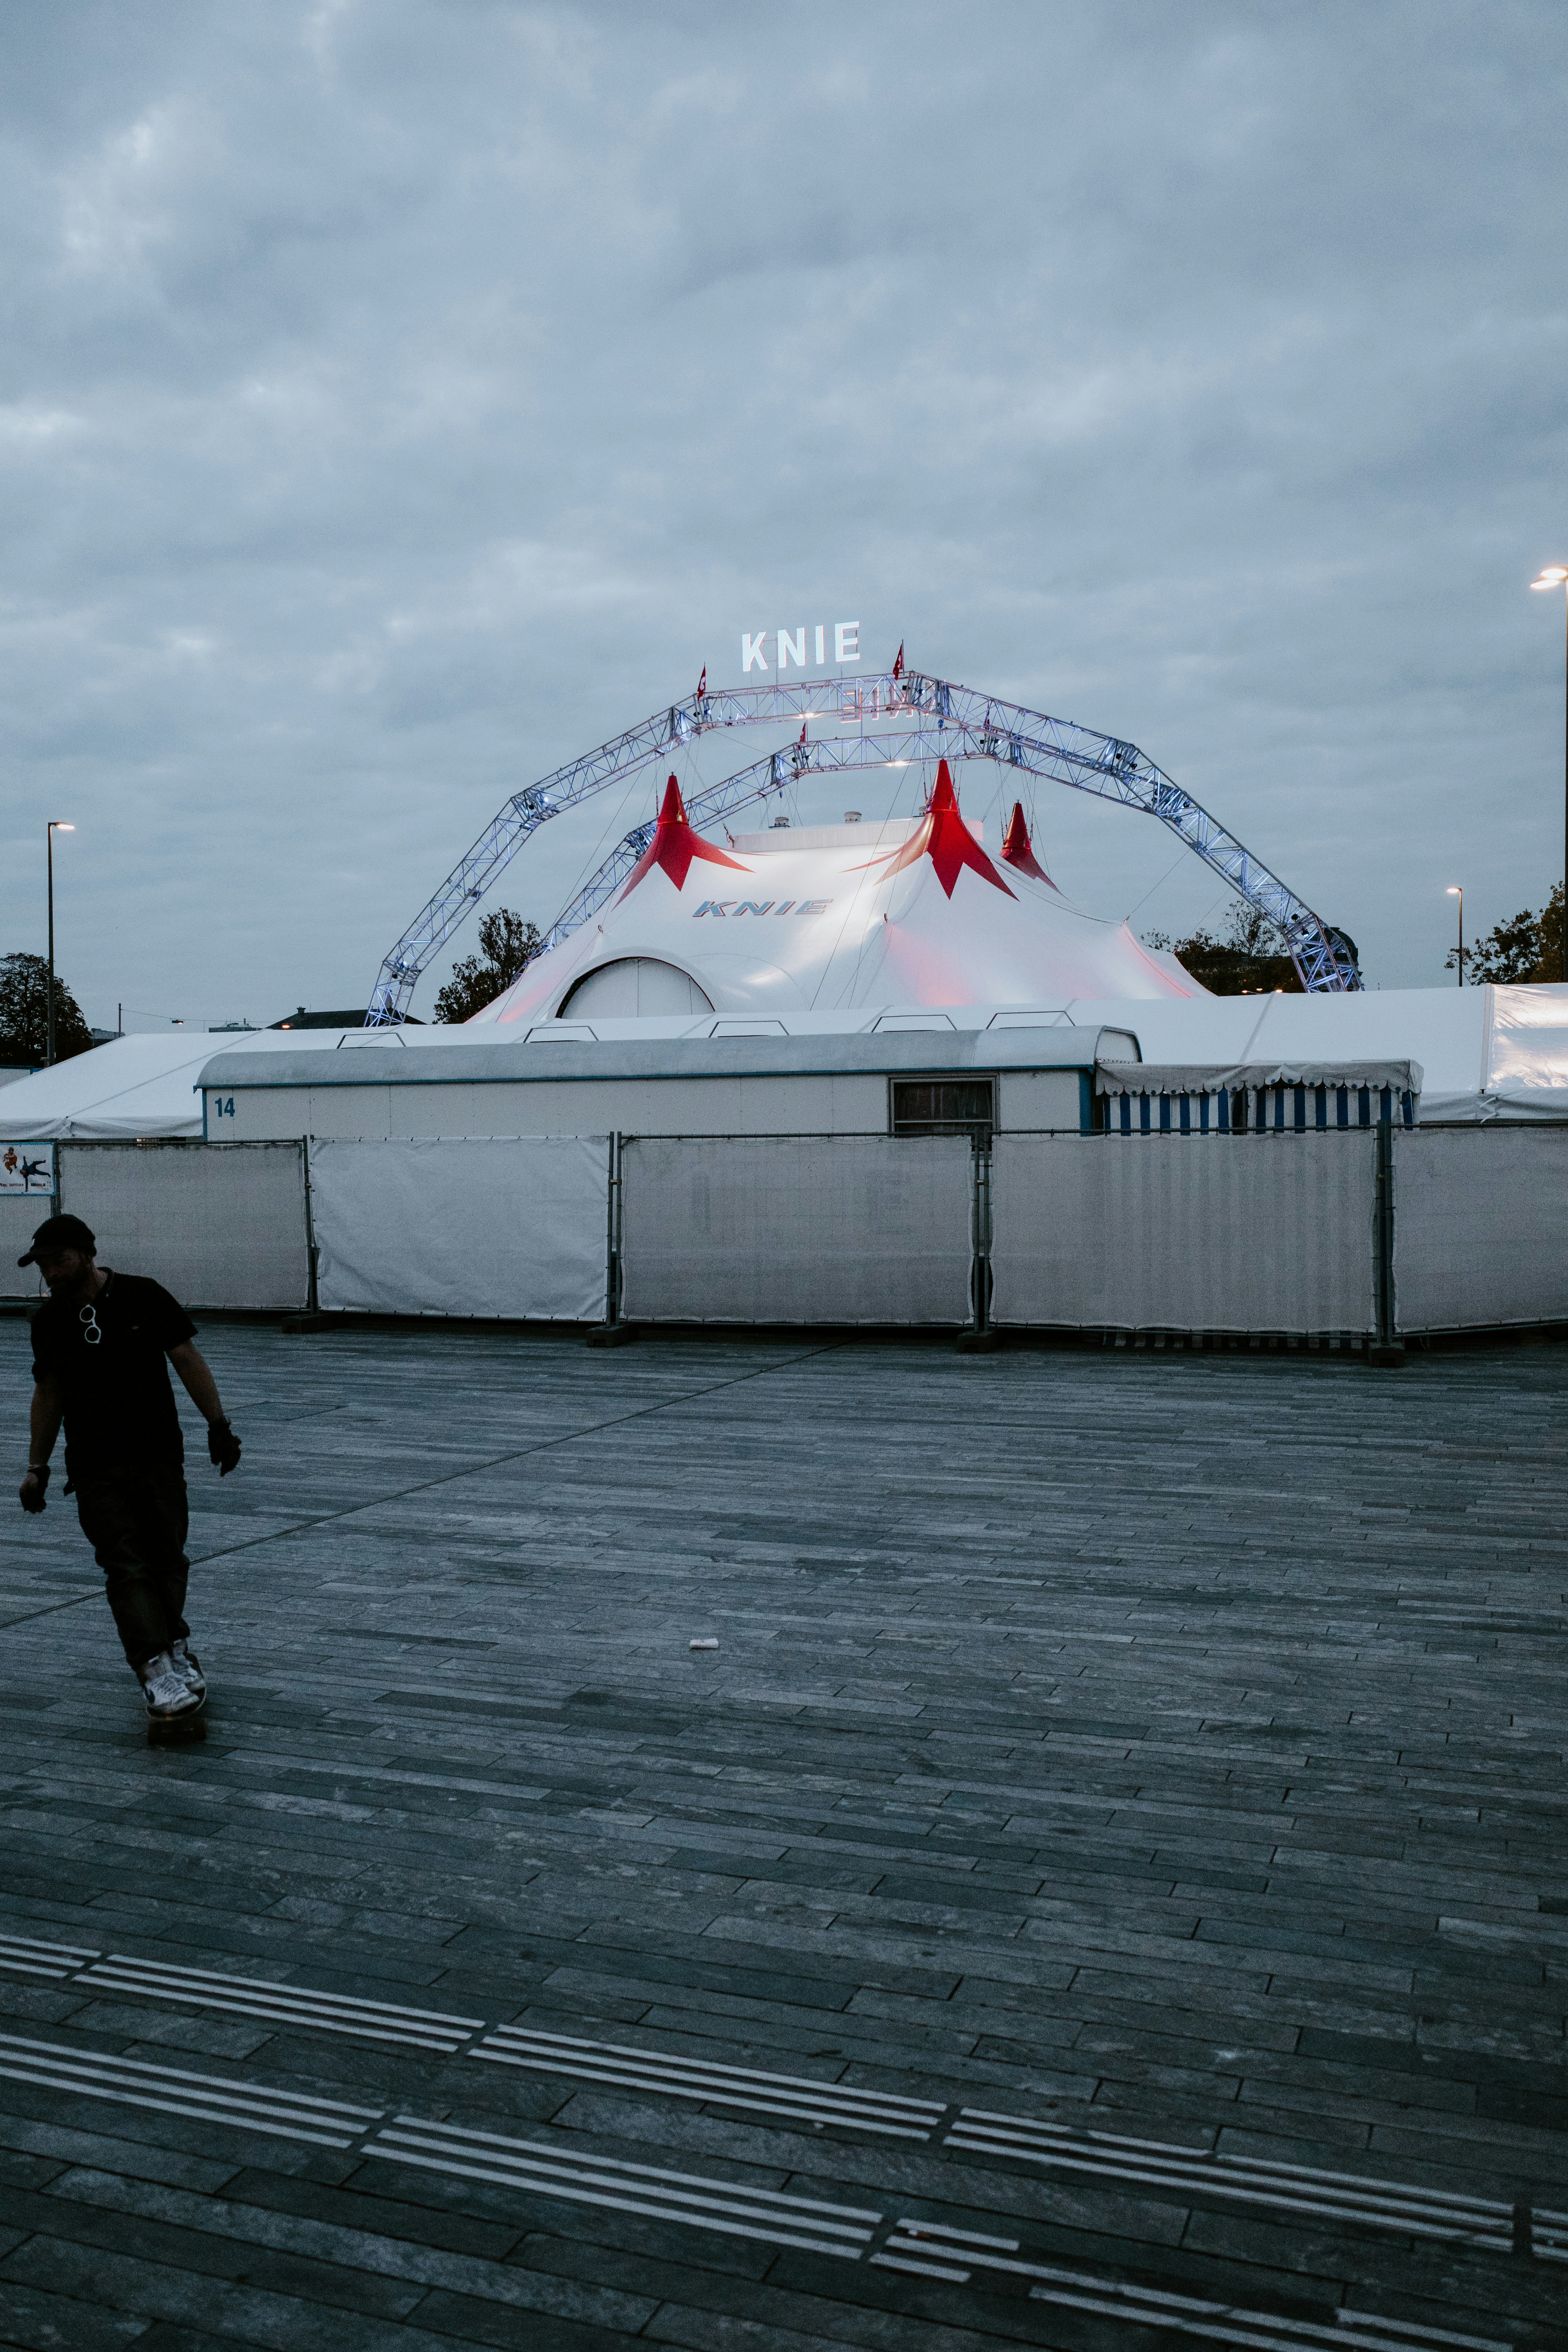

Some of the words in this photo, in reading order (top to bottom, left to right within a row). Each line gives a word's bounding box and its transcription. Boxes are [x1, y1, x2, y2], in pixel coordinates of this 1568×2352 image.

[742, 621, 860, 671] KNIE
[692, 899, 834, 917] KNIE
[215, 1098, 235, 1117] 14
